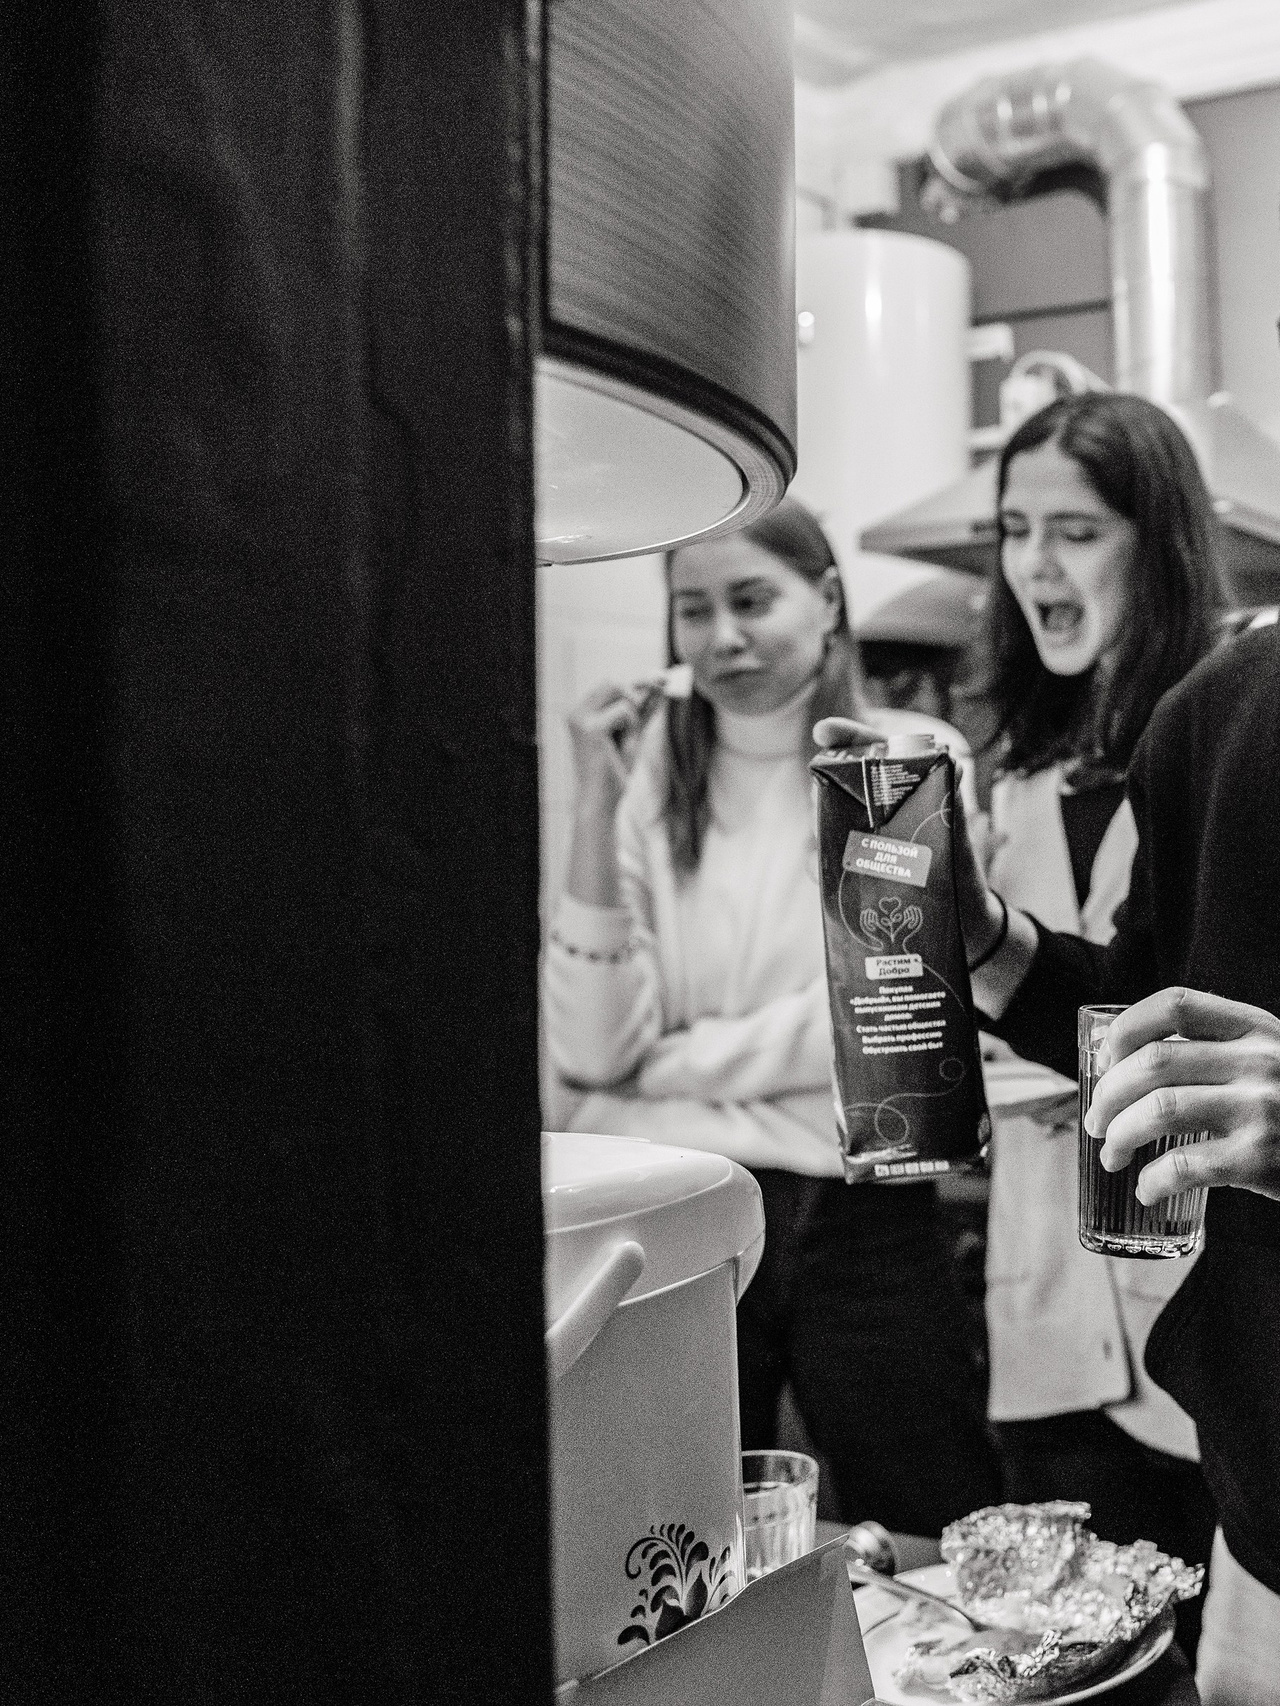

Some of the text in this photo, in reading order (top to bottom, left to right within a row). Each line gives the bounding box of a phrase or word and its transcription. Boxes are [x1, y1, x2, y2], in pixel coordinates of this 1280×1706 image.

[861, 838, 918, 858] С ПОЛЬЗОЙ
[874, 851, 897, 864] ДЛЯ
[856, 857, 911, 879] ОБЩЕСТВА
[876, 957, 911, 967] Растим
[878, 966, 910, 976] Добро
